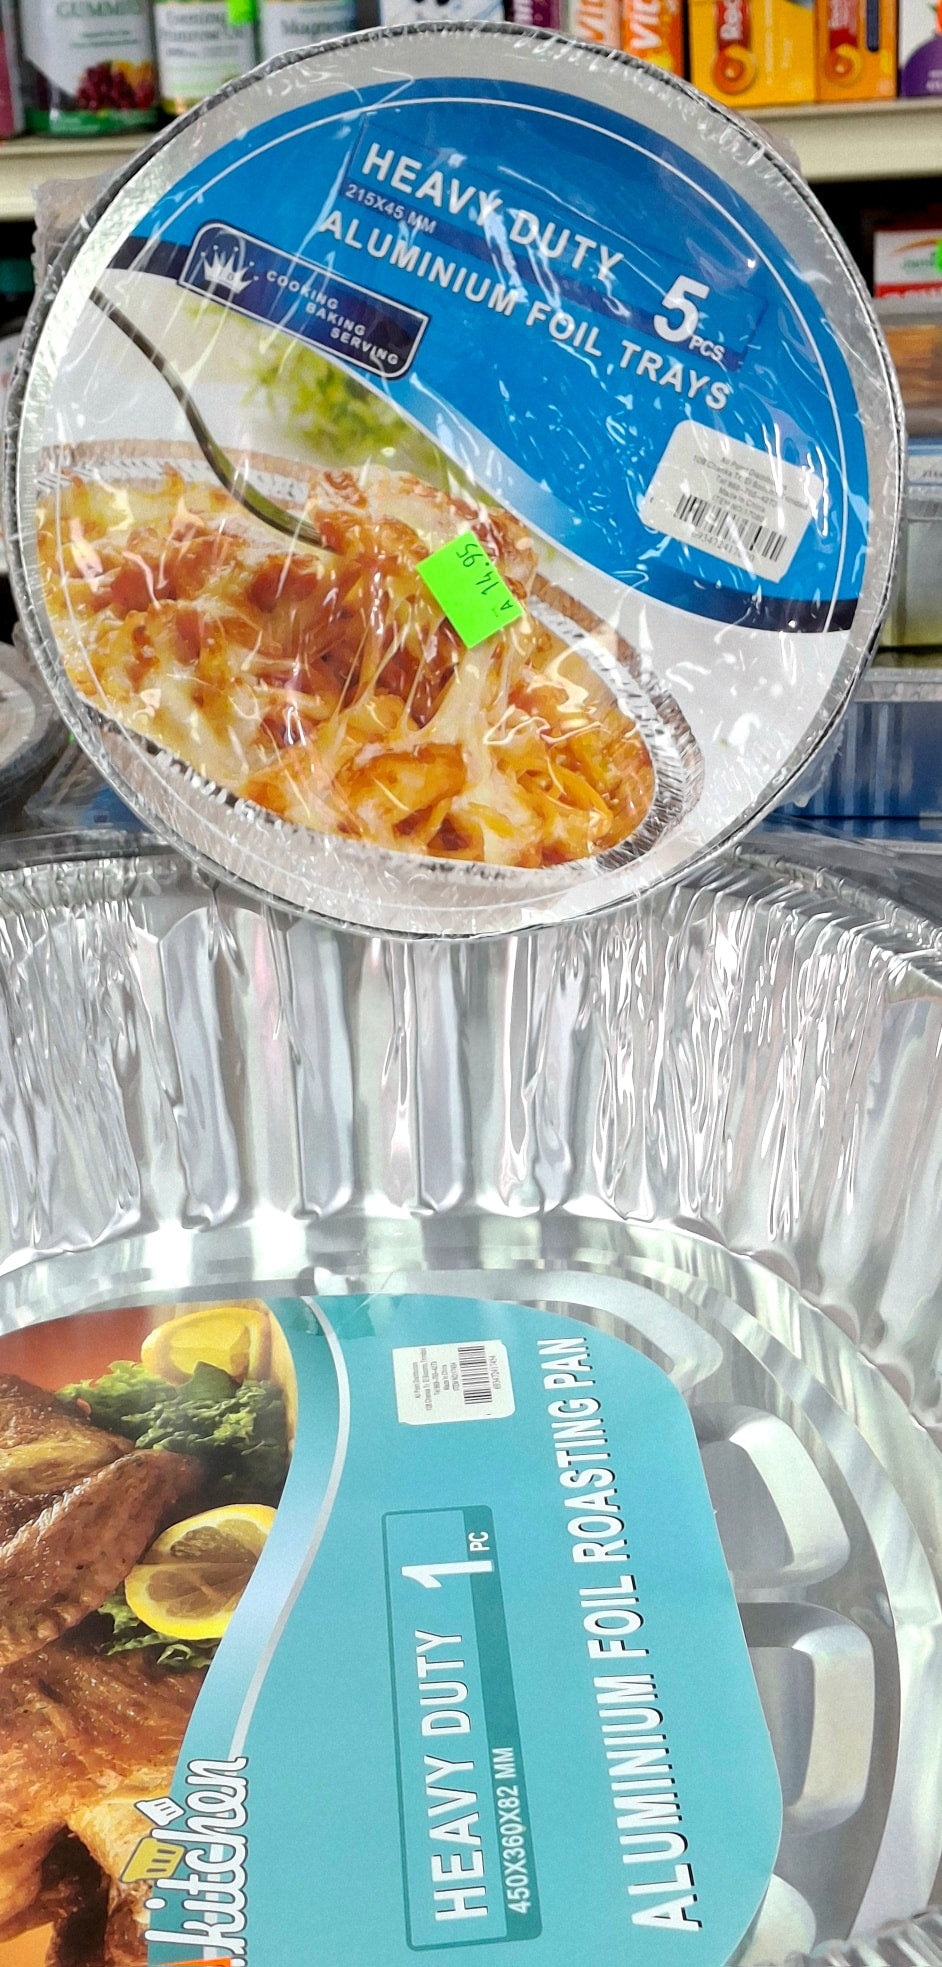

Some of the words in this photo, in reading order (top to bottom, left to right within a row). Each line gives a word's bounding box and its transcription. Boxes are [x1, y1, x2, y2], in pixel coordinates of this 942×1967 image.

[344, 183, 405, 221] 215X45
[406, 210, 438, 234] MM
[361, 142, 504, 228] HEAVY
[509, 209, 624, 281] DUTY
[266, 269, 339, 311] COOKING
[305, 301, 367, 337] BAKING
[319, 210, 519, 316] ALUMINIUM
[526, 301, 602, 357] FOIL
[619, 339, 731, 411] TRAYS
[653, 274, 710, 343] 5
[688, 333, 726, 362] PCS
[330, 326, 400, 365] SERVING
[455, 543, 500, 595] 14.95
[536, 1336, 596, 1391] PAN
[547, 1396, 632, 1565] ROASTING
[401, 1558, 495, 1590] 1
[468, 1531, 490, 1552] PC
[579, 1574, 649, 1660] FOIL
[415, 1629, 472, 1737] DUTY
[492, 1746, 515, 1780] MM
[593, 1673, 702, 1932] ALUMINIUM
[144, 1757, 249, 1956] kitchen
[423, 1755, 489, 1922] HEAVY
[497, 1784, 532, 1916] 450X360X82
